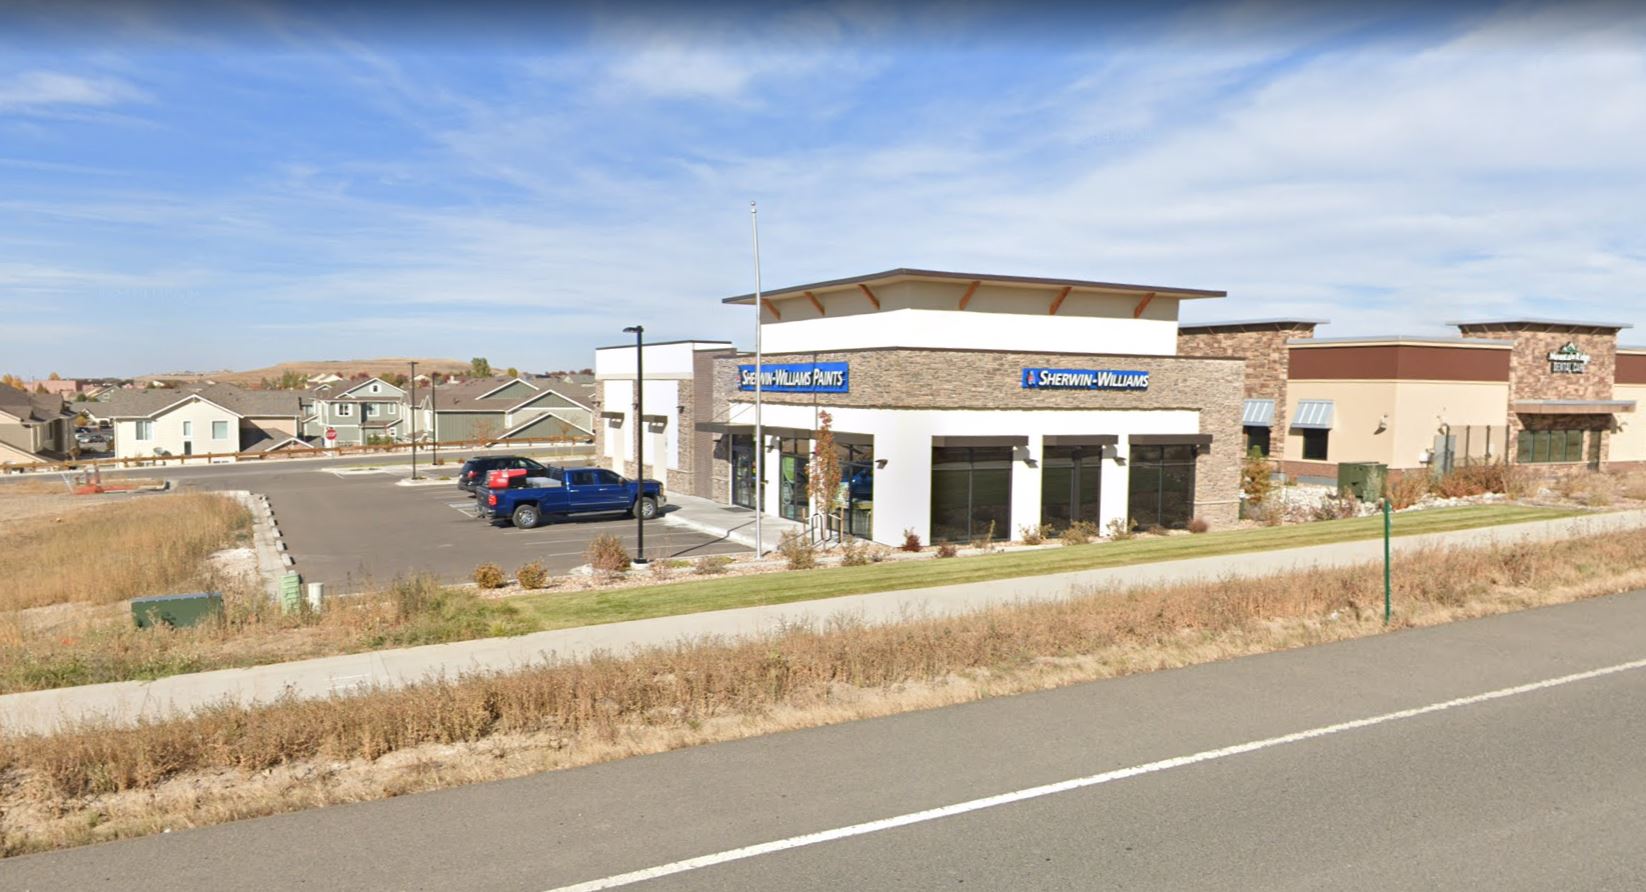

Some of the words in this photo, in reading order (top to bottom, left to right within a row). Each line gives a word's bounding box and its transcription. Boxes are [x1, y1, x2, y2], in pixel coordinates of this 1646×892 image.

[742, 369, 812, 386] SHEWIN-WILLIAMS
[813, 368, 843, 386] PAINTS
[1038, 370, 1149, 387] SHERWIN-WILLIAMS
